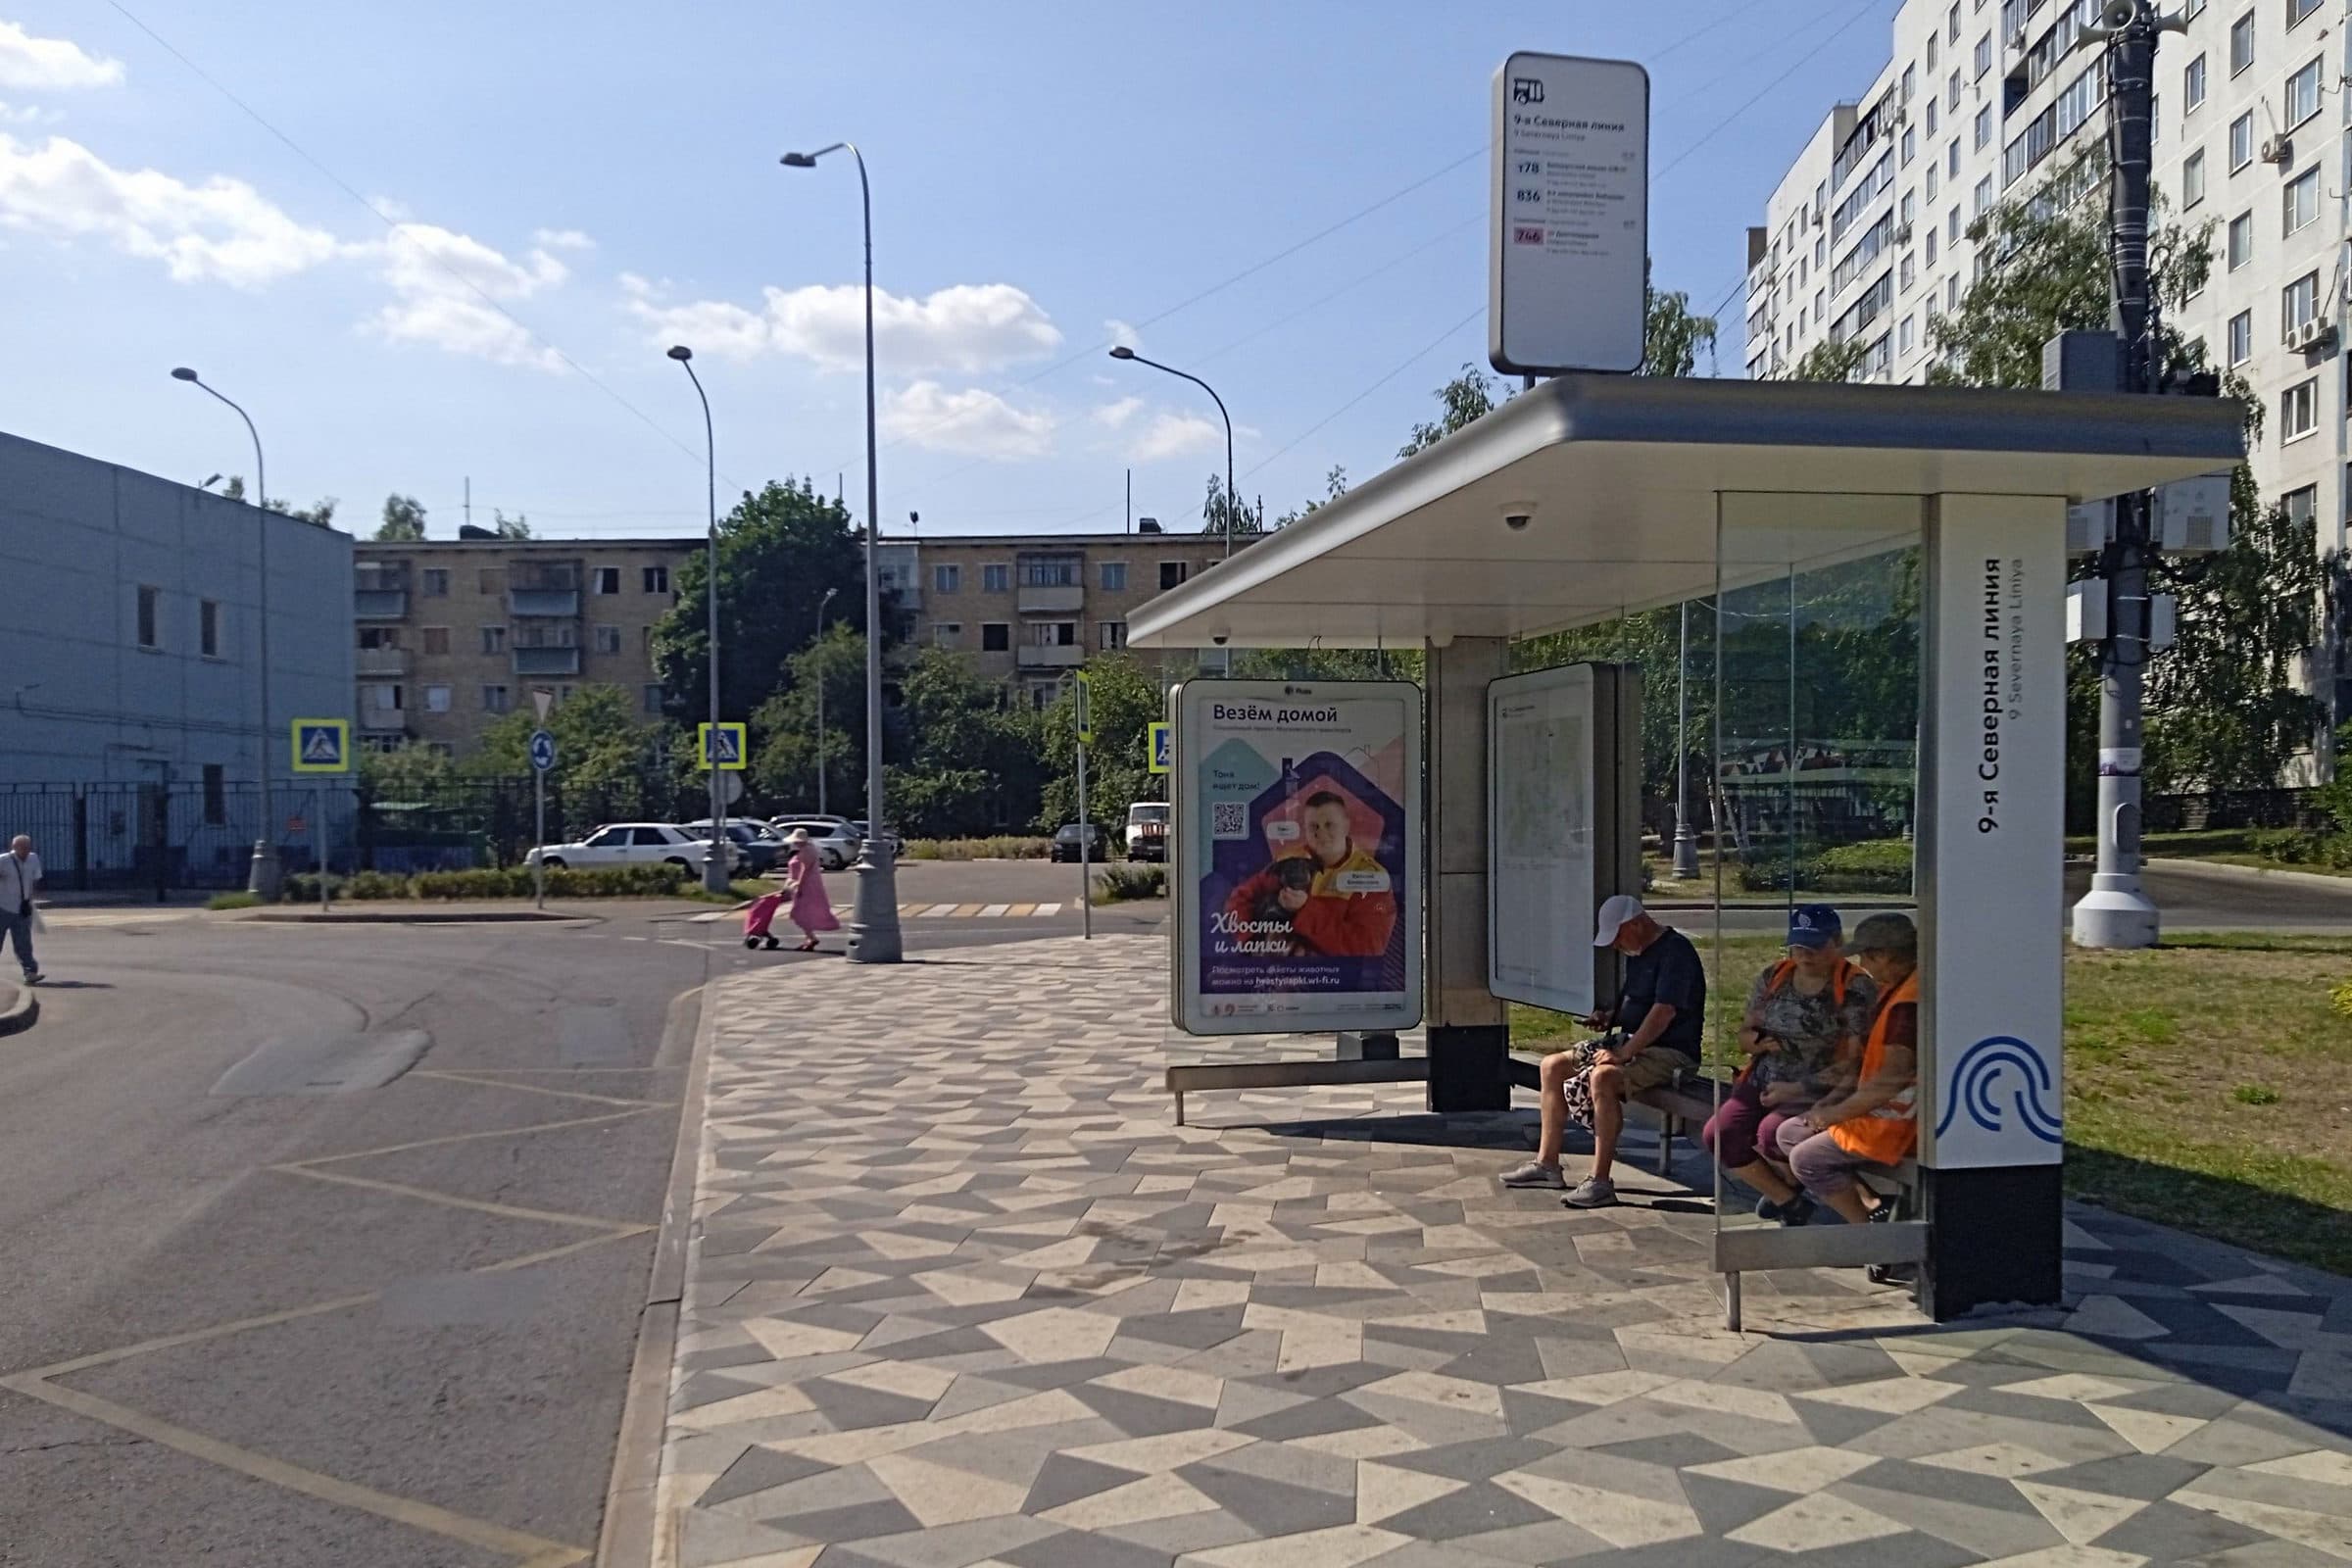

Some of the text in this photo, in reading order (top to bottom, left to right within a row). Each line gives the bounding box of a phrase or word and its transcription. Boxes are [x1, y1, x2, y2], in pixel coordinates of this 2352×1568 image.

[1534, 115, 1589, 130] Северная
[1591, 122, 1625, 132] линия
[1516, 189, 1541, 203] 836
[2007, 559, 2026, 720] 9 Severnaya Liniya
[1978, 559, 2003, 834] 9-я Северная линия
[1213, 704, 1338, 723] Везём домой
[1212, 769, 1235, 779] Тоня
[1210, 910, 1294, 934] Хвосты
[1214, 939, 1291, 954] и лапки
